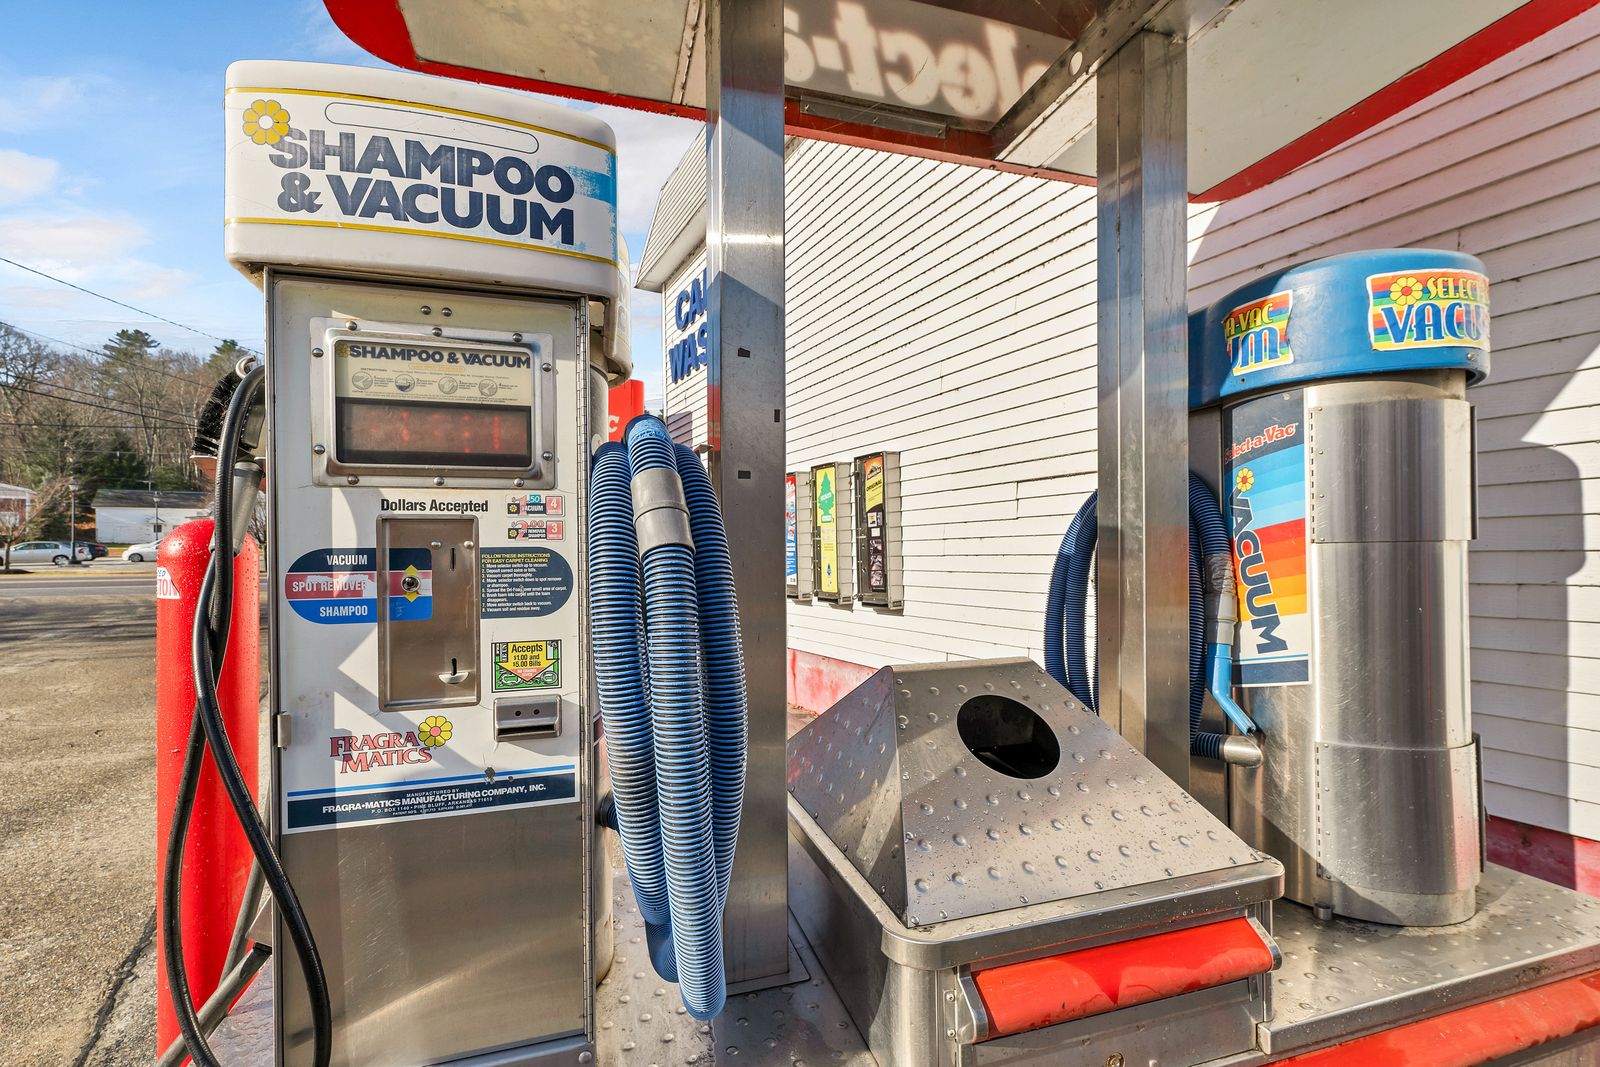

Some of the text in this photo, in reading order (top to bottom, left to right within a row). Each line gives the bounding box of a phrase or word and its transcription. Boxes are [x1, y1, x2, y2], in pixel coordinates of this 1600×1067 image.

[269, 128, 575, 203] SHAMPOO
[277, 171, 575, 246] & VACUUM
[350, 345, 444, 363] SHAMPOO
[447, 351, 460, 364] &
[461, 352, 531, 369] VACUUM
[381, 499, 489, 514] Dollars Accepted
[551, 499, 557, 508] 4
[551, 523, 558, 533] 3
[327, 555, 367, 566] VACUUM
[1230, 487, 1288, 654] VACUUM
[292, 581, 320, 592] SPOT
[319, 605, 368, 617] SHAMPOO
[511, 643, 543, 653] Accepts
[330, 731, 420, 757] FRAGRA
[340, 747, 433, 774] MATICS
[401, 790, 480, 805] MANUFACTURING
[481, 785, 527, 797] COMPANY,
[529, 783, 547, 792] INC.
[406, 789, 451, 798] MANUFACTURED
